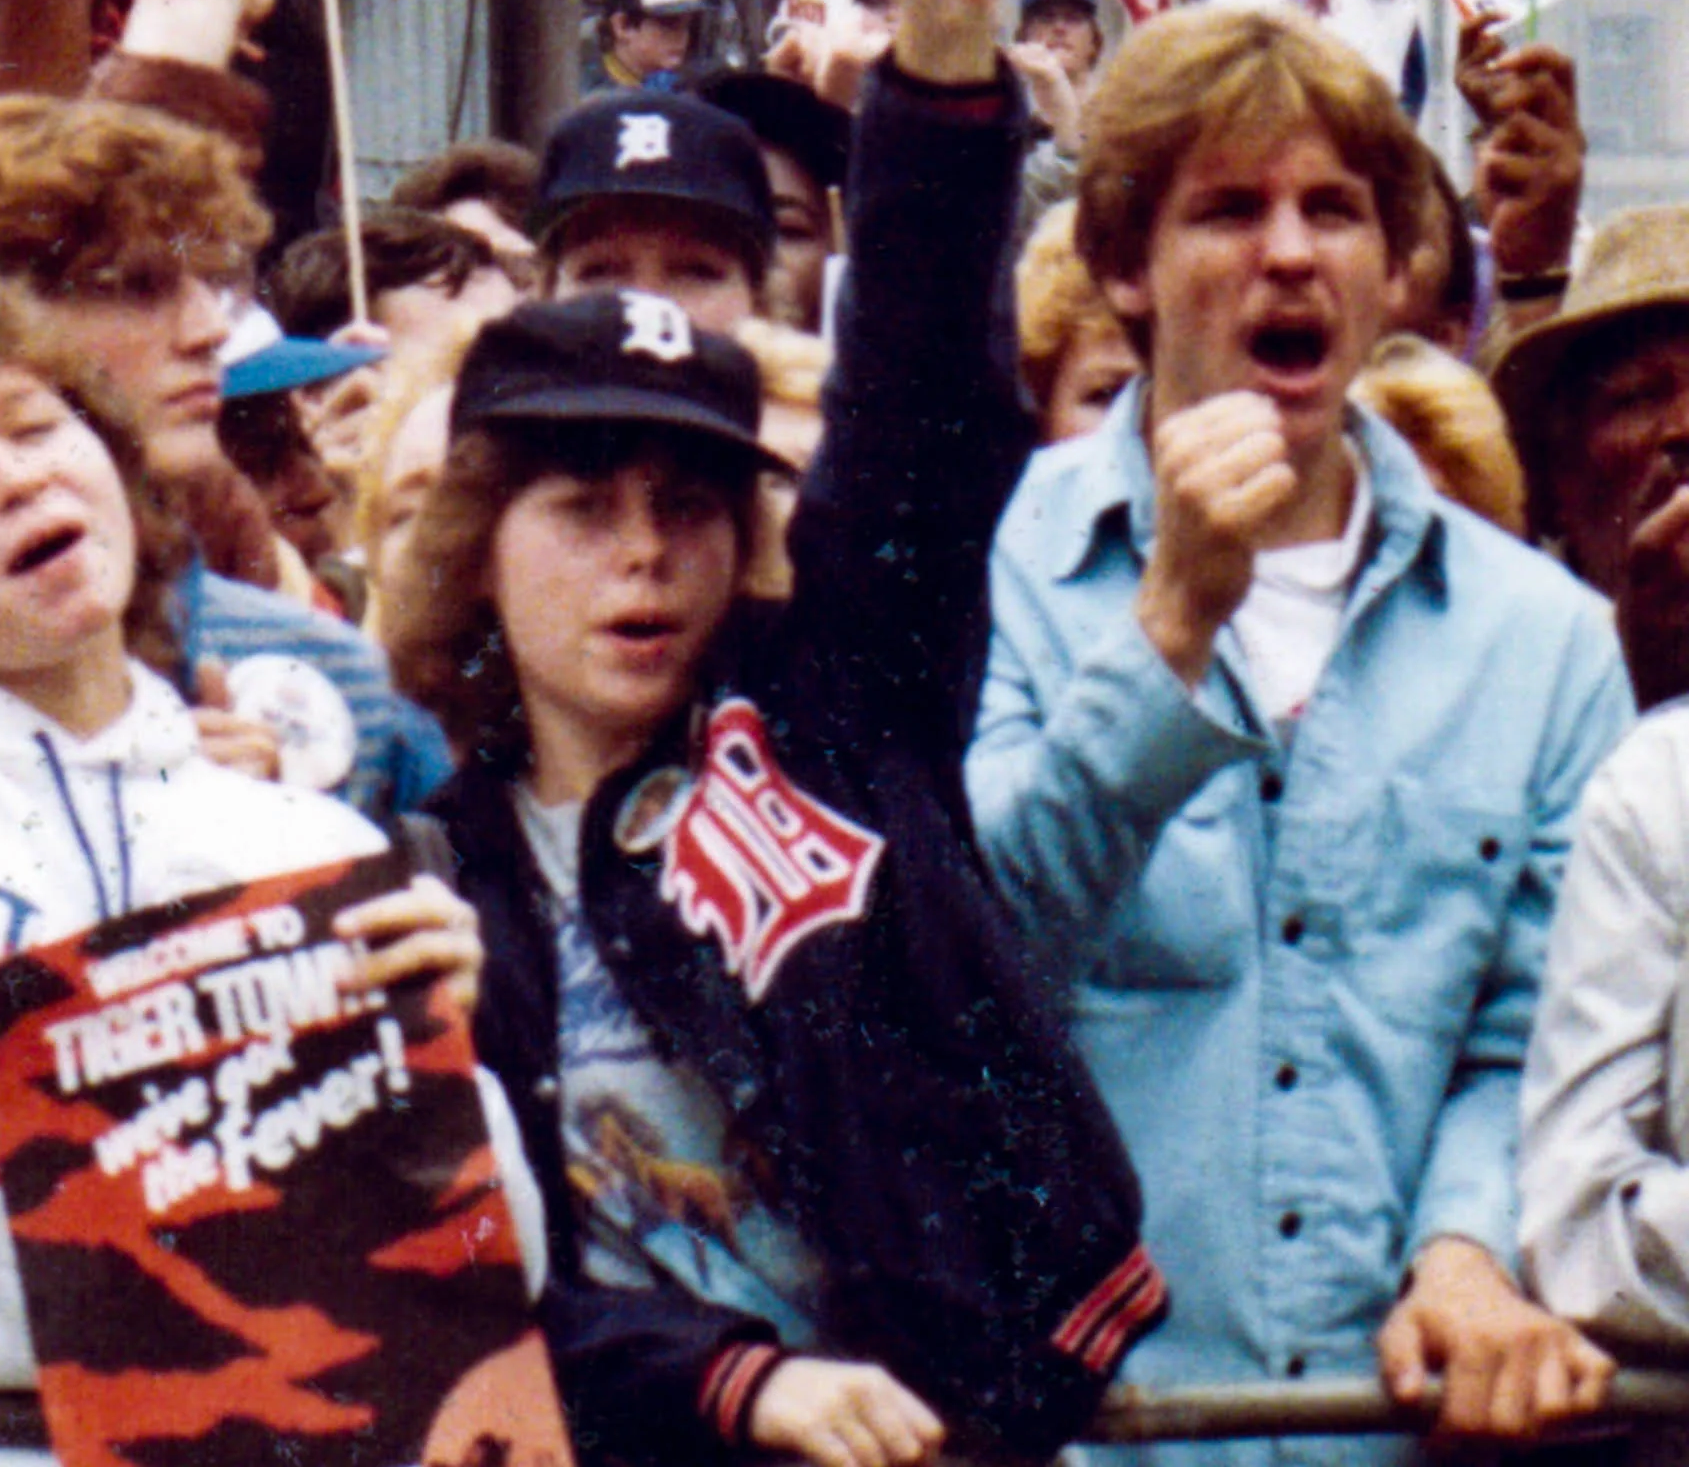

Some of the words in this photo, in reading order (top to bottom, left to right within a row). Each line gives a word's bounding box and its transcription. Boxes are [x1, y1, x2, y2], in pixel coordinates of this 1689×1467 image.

[85, 918, 250, 1002] WELCOME
[248, 905, 305, 951] TO
[43, 980, 208, 1094] TIGER
